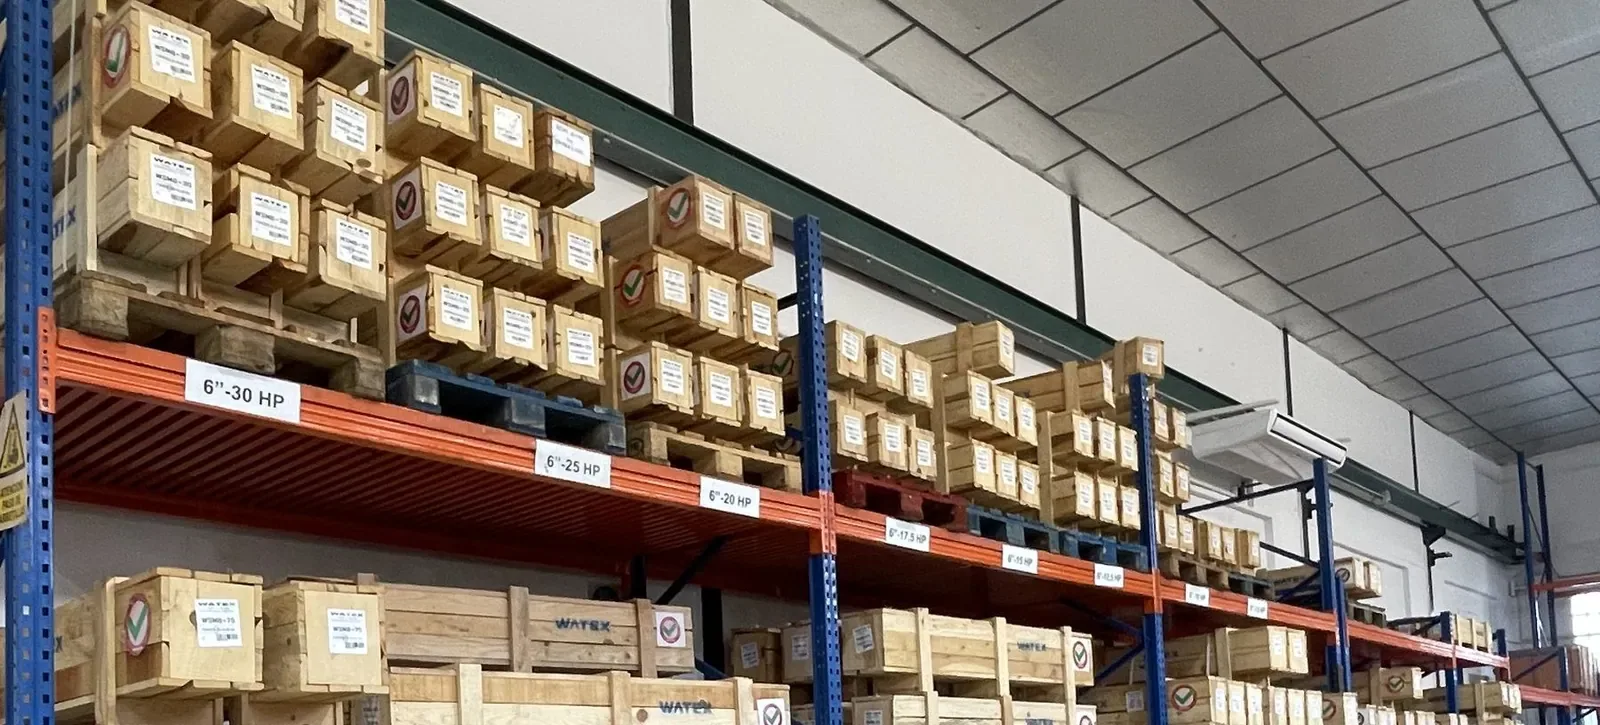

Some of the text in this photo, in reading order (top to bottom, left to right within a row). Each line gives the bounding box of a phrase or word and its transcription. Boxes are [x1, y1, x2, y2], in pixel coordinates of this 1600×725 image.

[259, 390, 285, 409] HP
[583, 463, 601, 477] HP
[738, 496, 752, 509] HP
[916, 534, 927, 544] HP
[1024, 557, 1033, 568] HP
[555, 617, 611, 632] WATEX
[659, 699, 713, 714] WATEX
